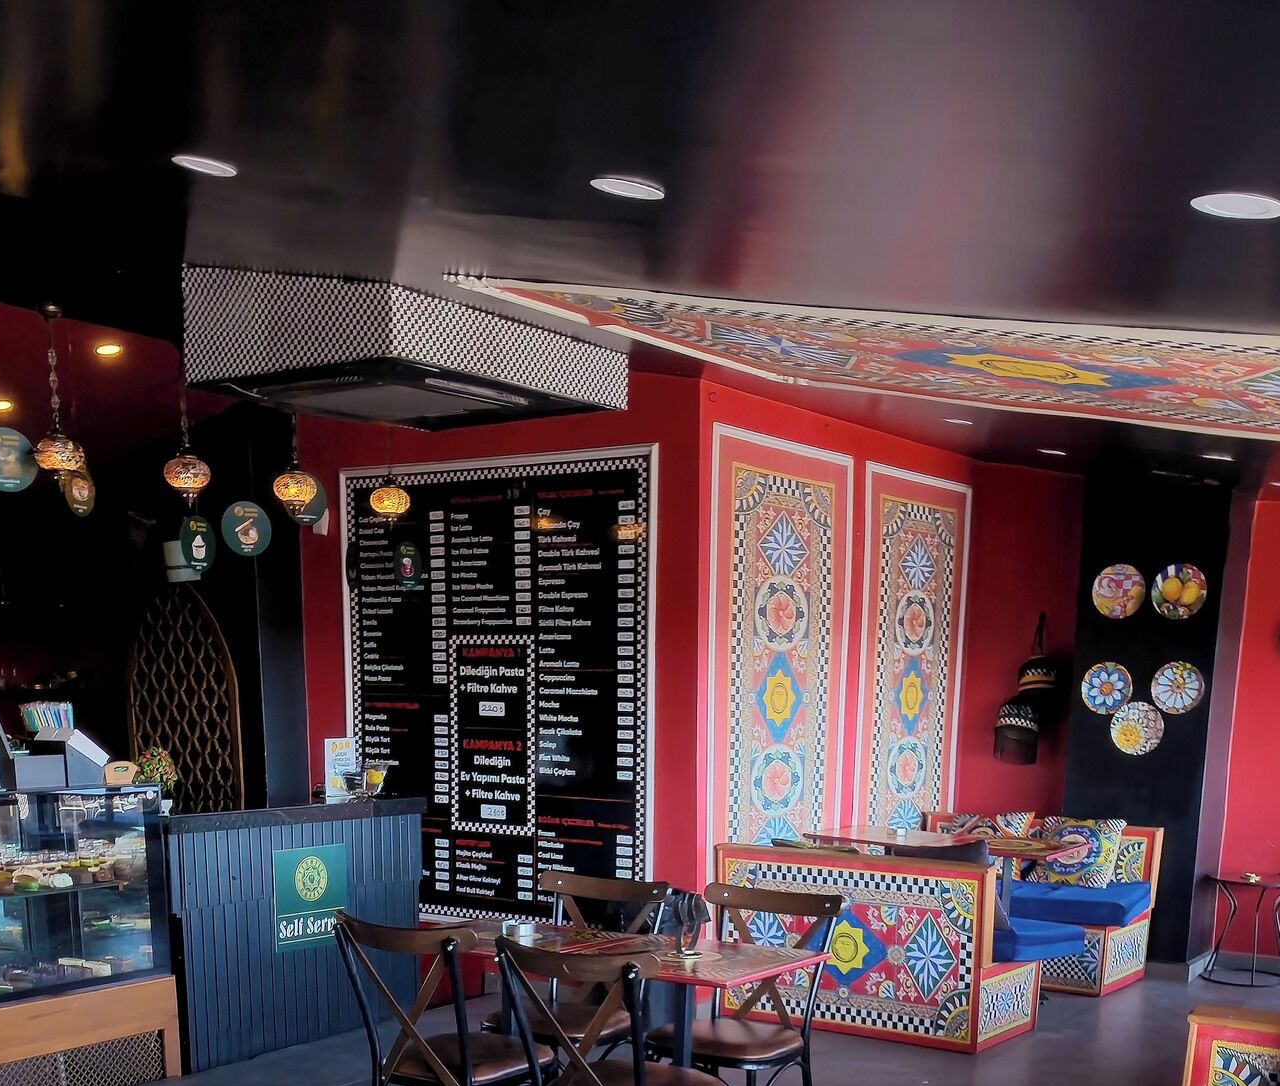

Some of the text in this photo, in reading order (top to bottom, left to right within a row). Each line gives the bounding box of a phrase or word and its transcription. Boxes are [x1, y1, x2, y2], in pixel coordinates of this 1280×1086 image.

[538, 508, 550, 518] Çay
[567, 521, 580, 529] Çay
[538, 578, 565, 586] Espresso
[460, 666, 525, 678] Dilediğin Pasta
[539, 674, 575, 682] Cappuccino
[467, 683, 489, 692] Filtre
[490, 683, 518, 693] Kahve
[539, 727, 583, 736] Sıcak Çikolata
[463, 739, 523, 752] KAMPANYA 2
[539, 740, 557, 749] Salep
[473, 755, 511, 768] Dilediğin
[551, 754, 570, 762] White
[460, 771, 526, 784] Ev Yapımı Pasta
[471, 789, 494, 799] Filtre
[494, 790, 521, 801] Kahve
[279, 917, 304, 938] Self
